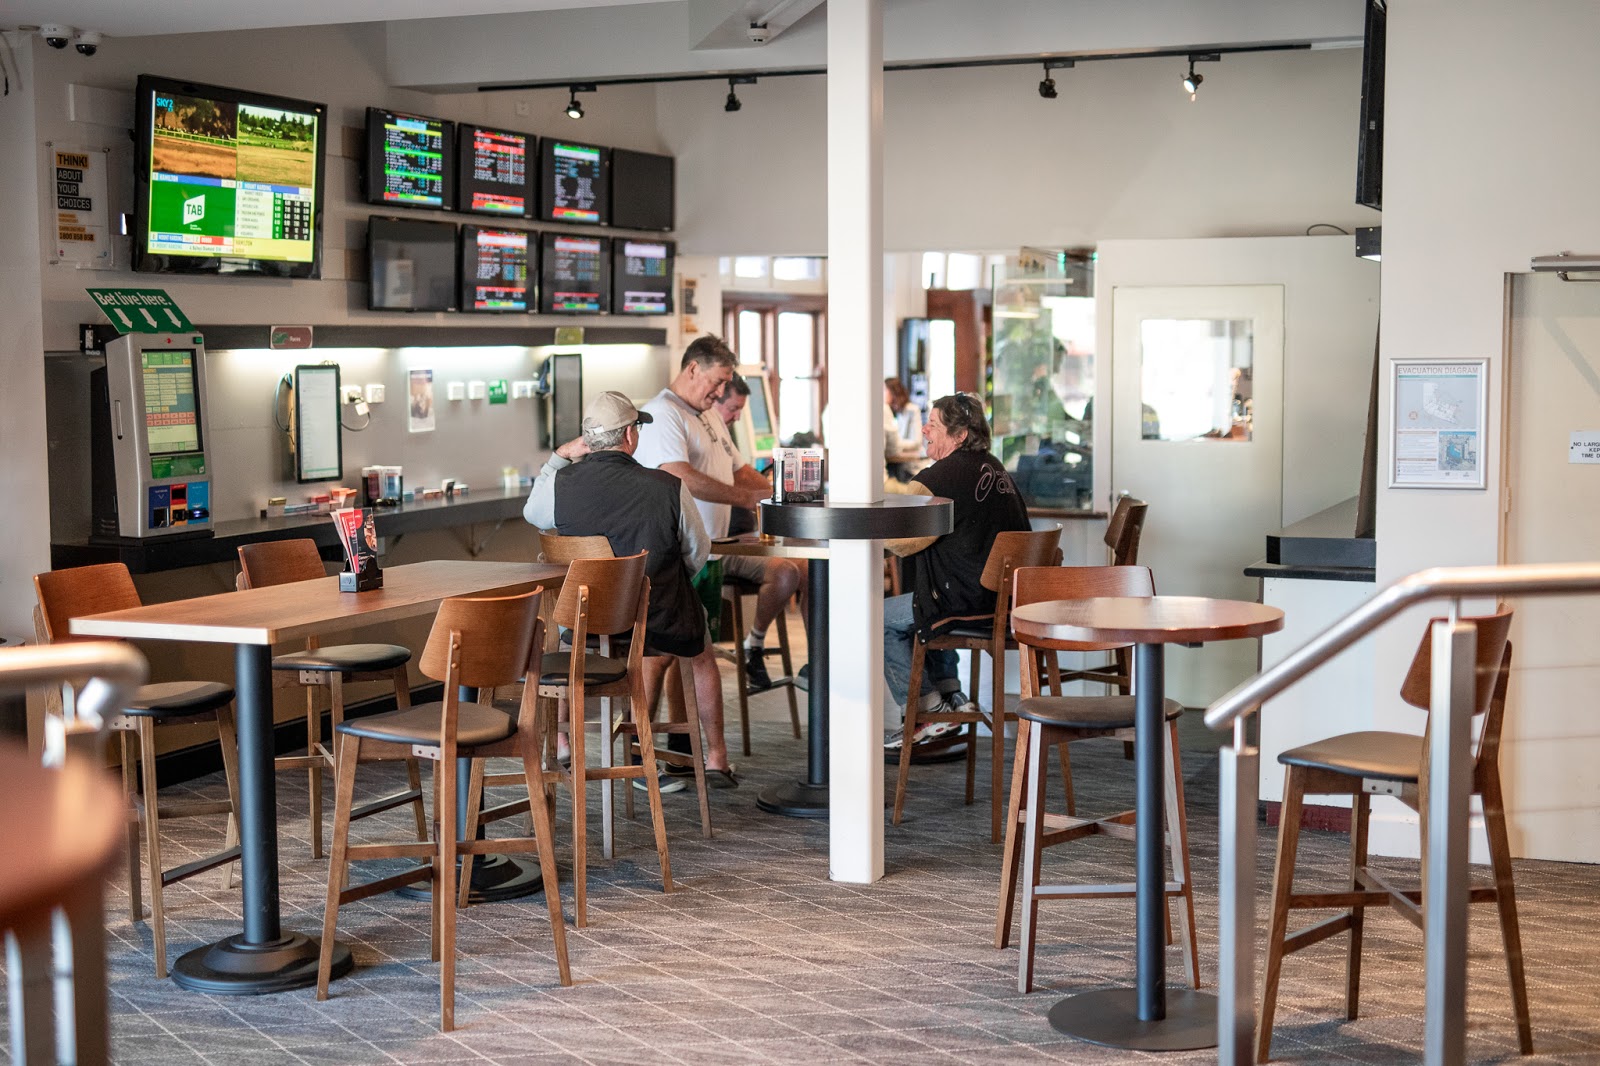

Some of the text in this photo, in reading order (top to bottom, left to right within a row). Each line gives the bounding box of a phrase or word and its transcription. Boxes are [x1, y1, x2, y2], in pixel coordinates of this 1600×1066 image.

[57, 153, 88, 168] THINK!
[58, 170, 82, 181] ABOUT
[58, 184, 78, 195] YOUR
[58, 197, 91, 210] CHOICES
[186, 204, 203, 216] TAB
[59, 232, 72, 240] 1800
[93, 292, 172, 306] Bet live here.
[1398, 366, 1478, 374] EVACUATION DIAGRAM
